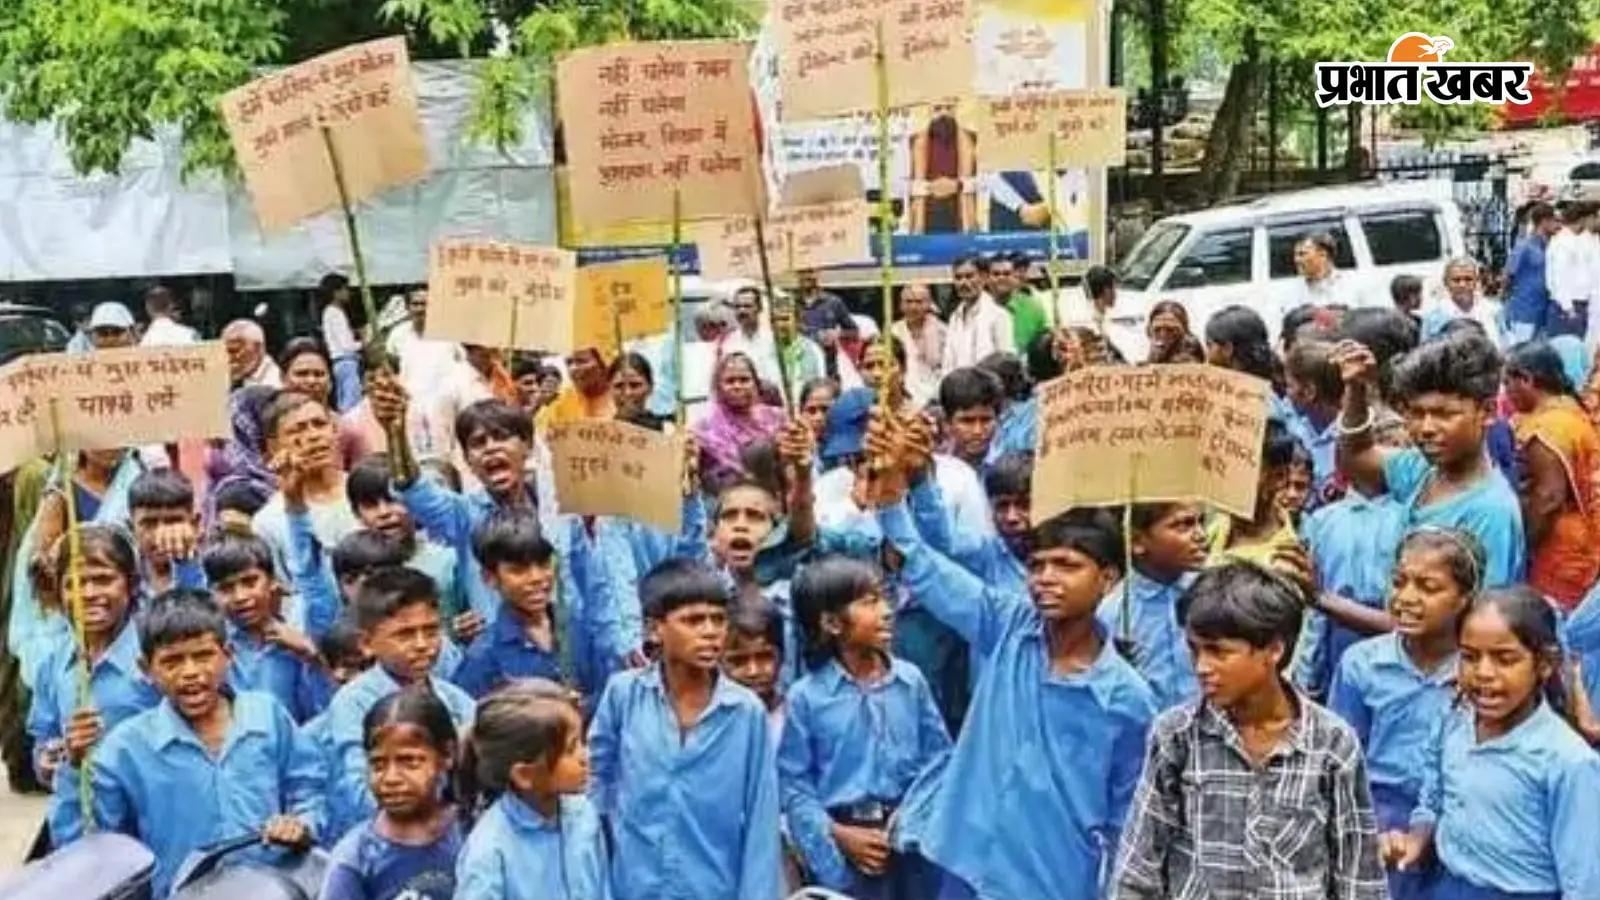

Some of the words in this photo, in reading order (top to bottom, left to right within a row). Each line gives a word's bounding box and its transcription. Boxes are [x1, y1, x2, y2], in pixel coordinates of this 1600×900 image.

[598, 56, 630, 85] नहीं
[639, 53, 686, 79] चलेगा
[598, 91, 632, 117] नहीं
[641, 90, 686, 113] चलेगा
[662, 154, 690, 180] नहीं
[699, 151, 743, 174] चलेगा
